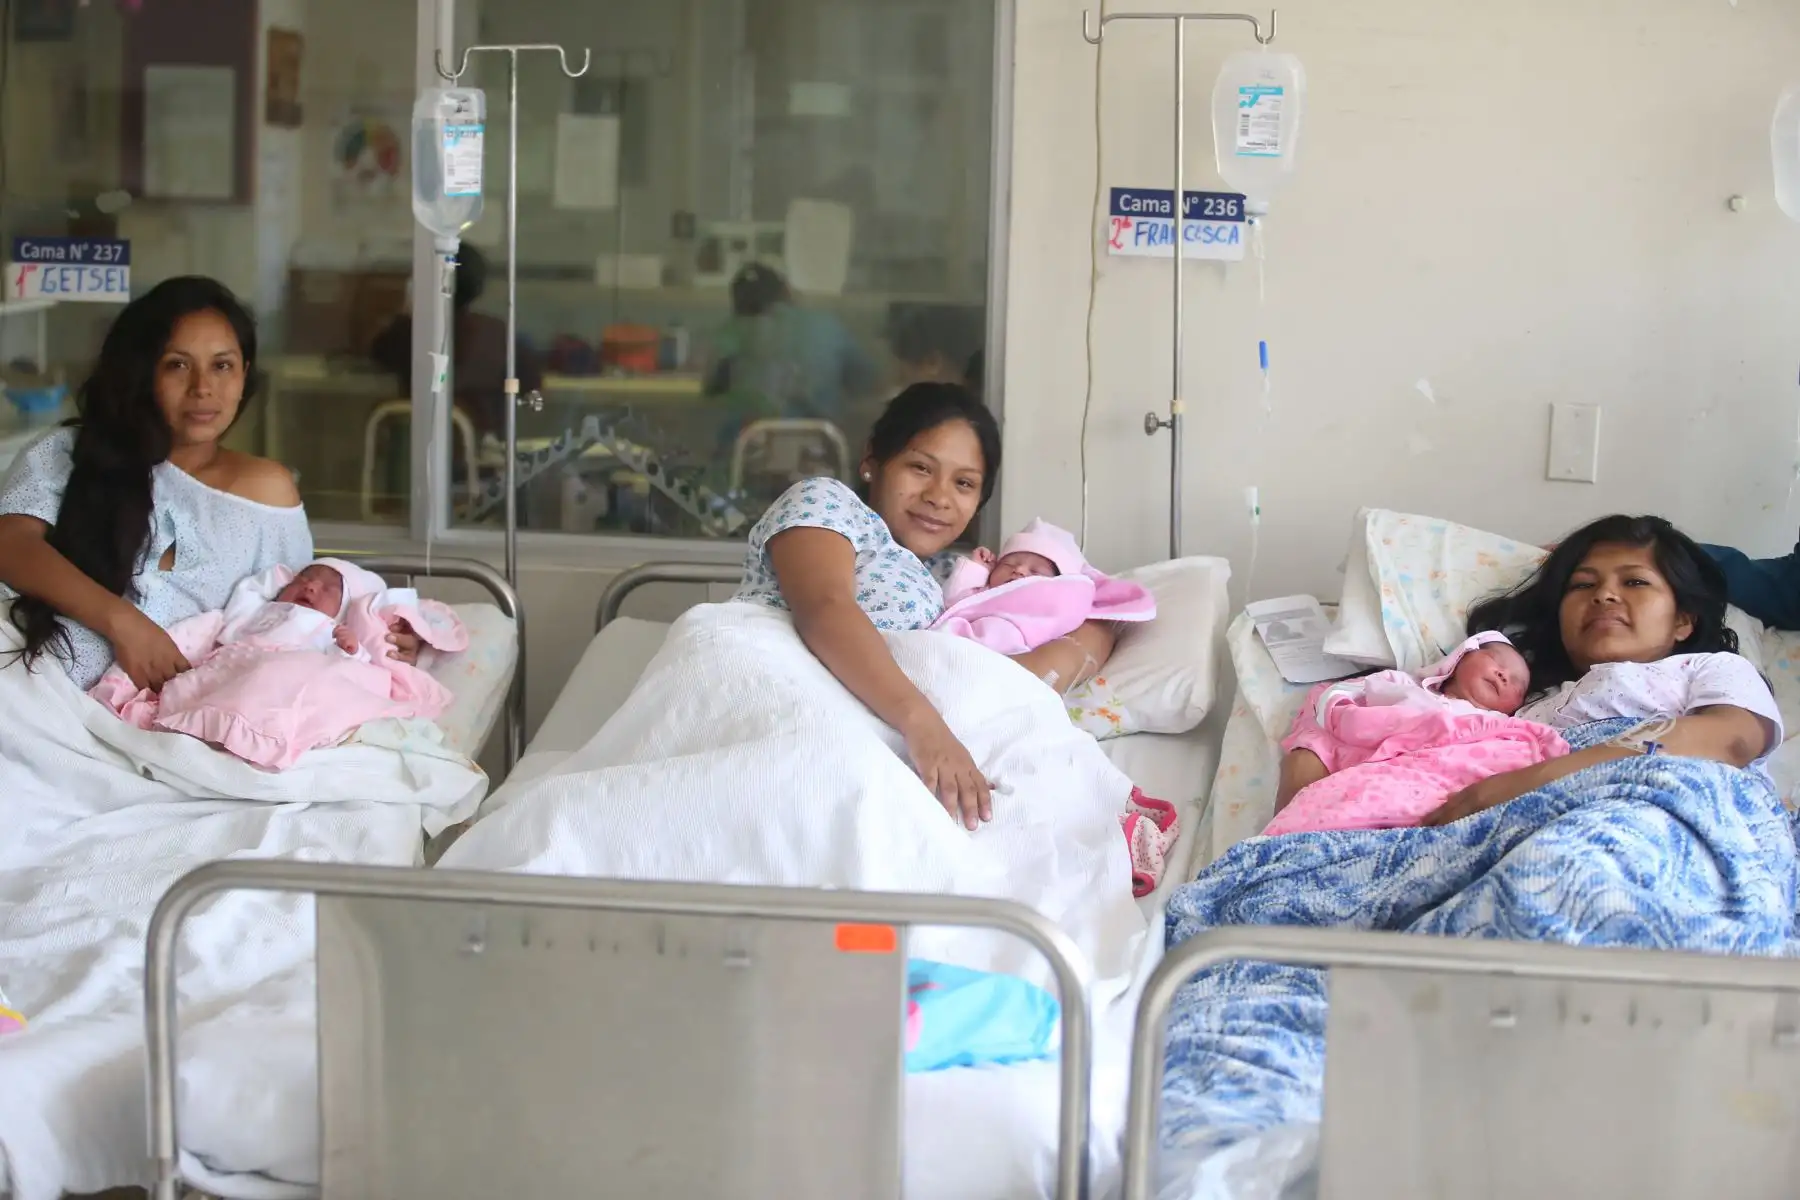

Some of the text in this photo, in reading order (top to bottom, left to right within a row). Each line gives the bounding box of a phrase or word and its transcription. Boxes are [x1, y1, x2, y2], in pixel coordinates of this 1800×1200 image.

[1119, 194, 1171, 213] Cama
[1203, 198, 1238, 216] 236
[20, 242, 123, 262] Cama N° 237
